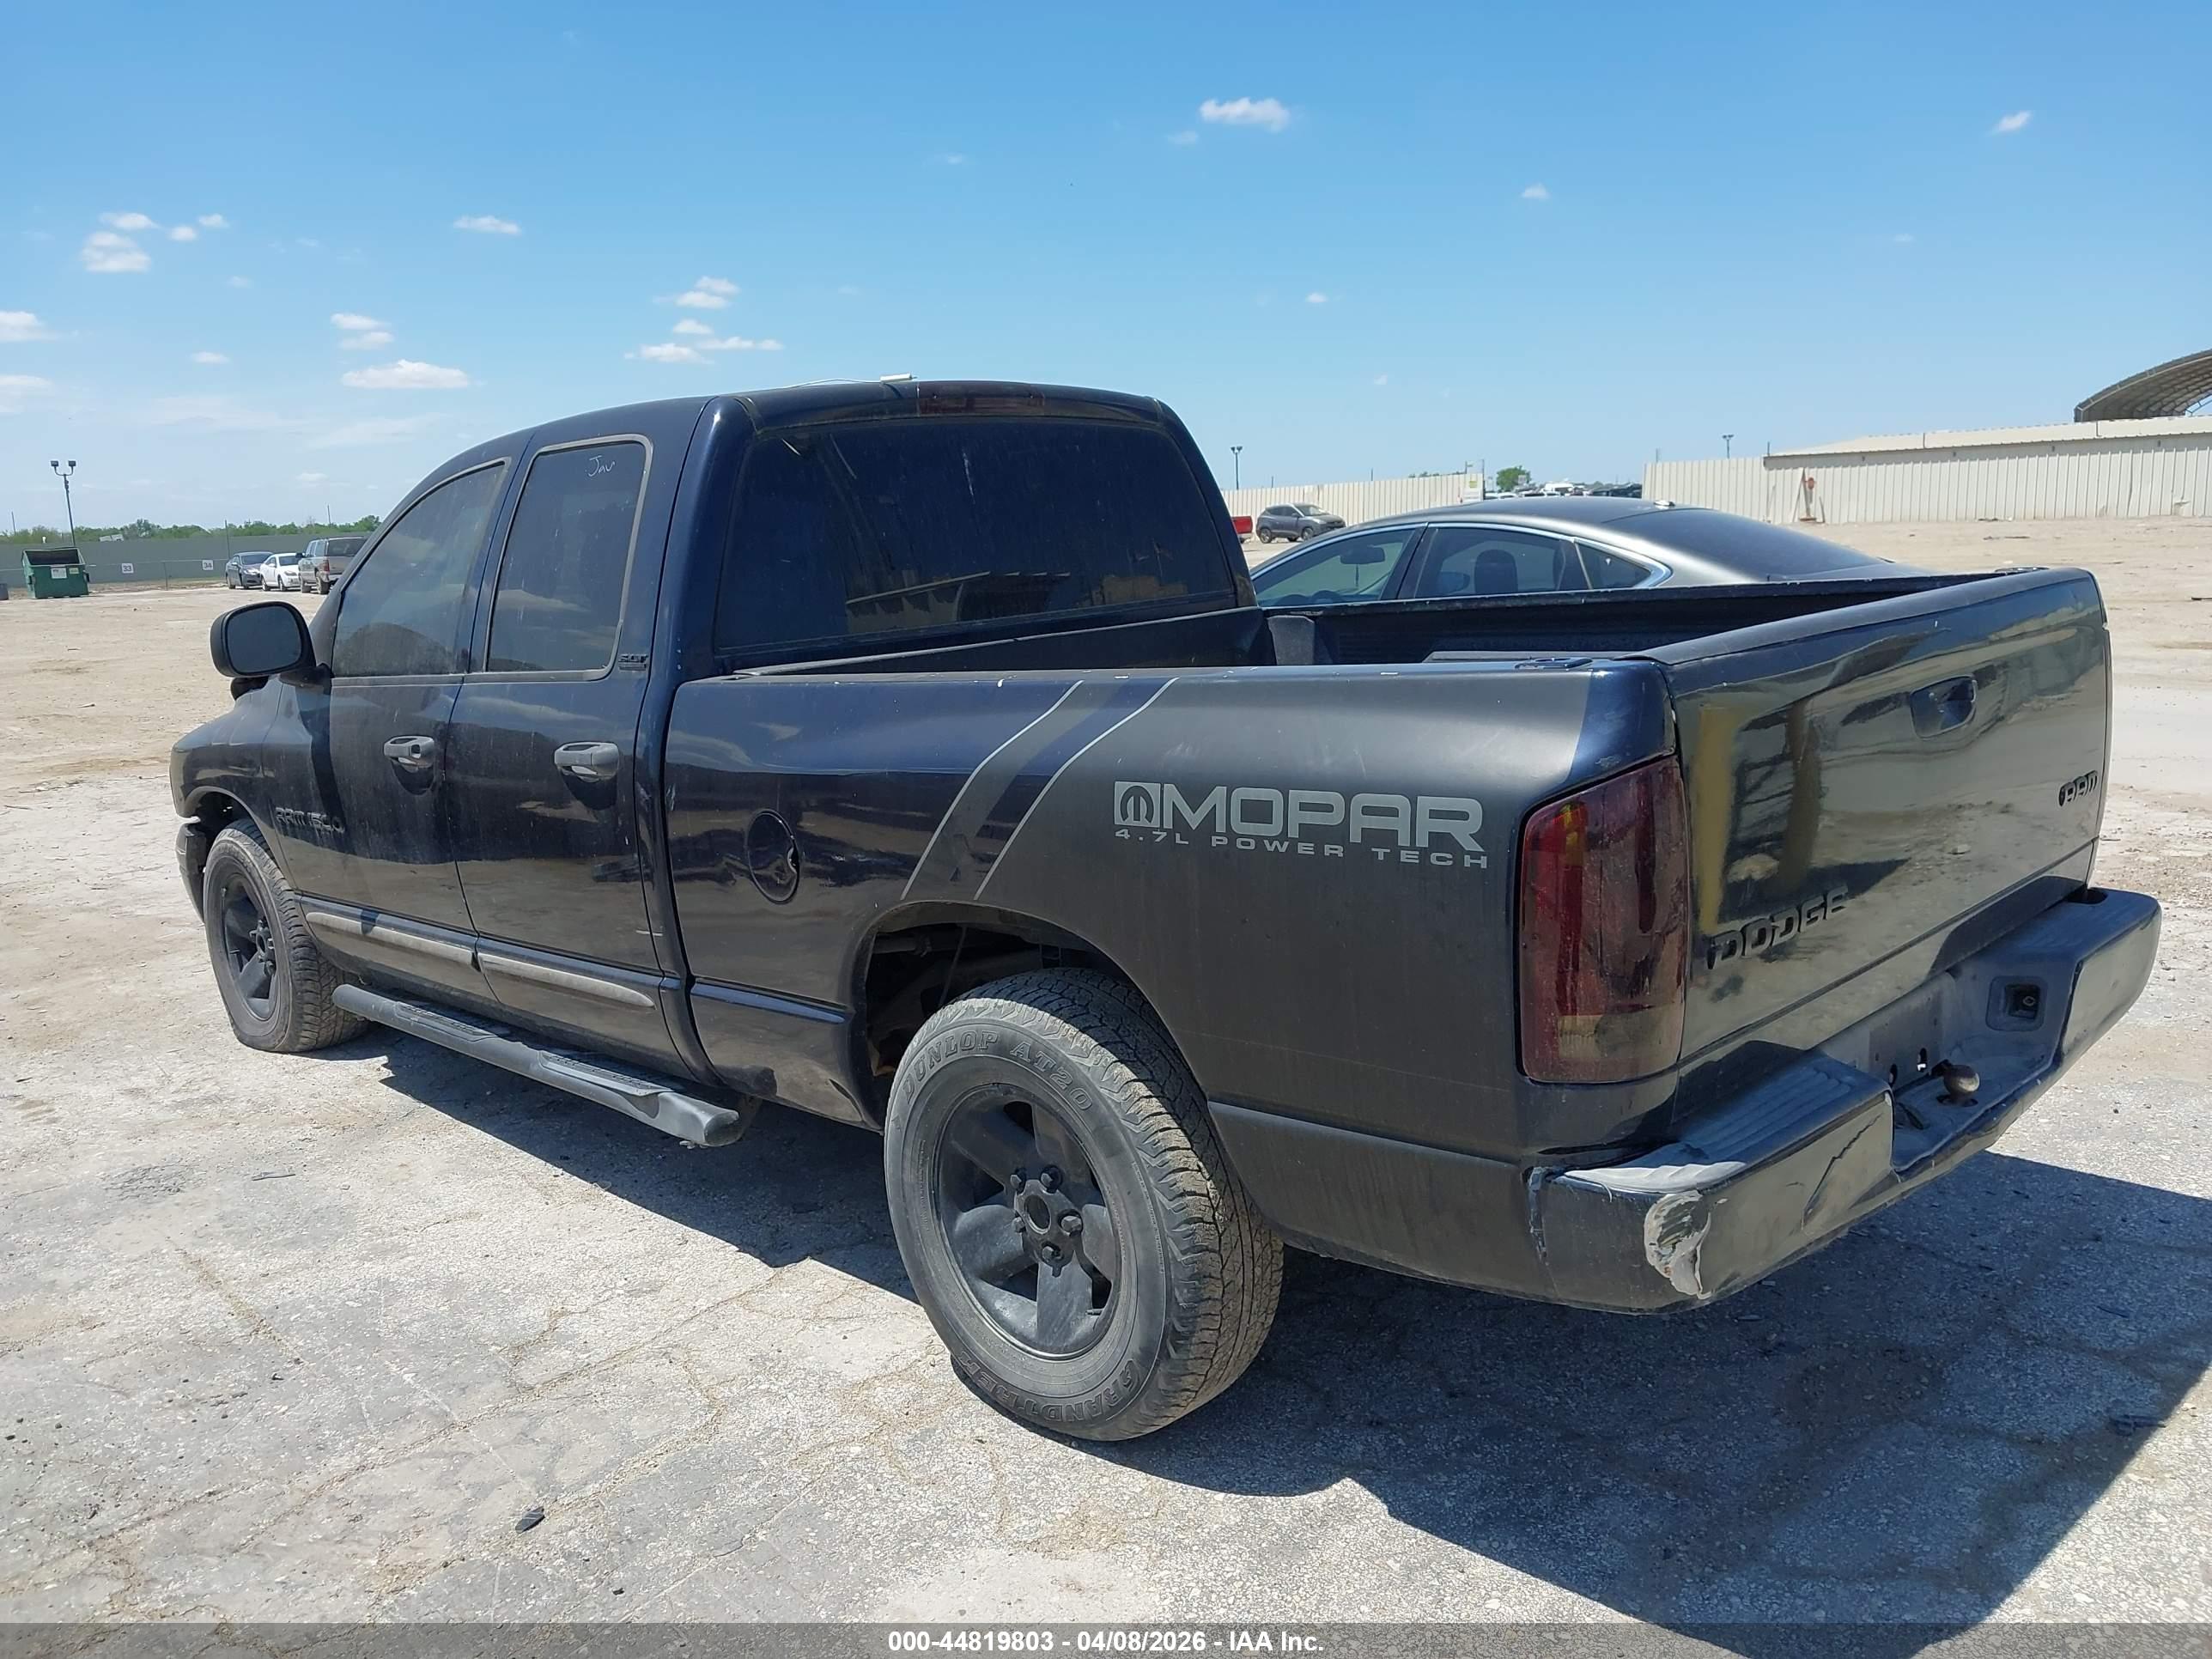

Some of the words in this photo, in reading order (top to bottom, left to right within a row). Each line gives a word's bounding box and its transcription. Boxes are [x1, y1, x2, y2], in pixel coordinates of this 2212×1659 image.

[1163, 783, 1486, 853] MOPAR
[2058, 770, 2098, 806] RAM
[1115, 828, 1189, 845] 4.7L
[1211, 835, 1344, 858] POWER
[1371, 847, 1488, 869] TECH
[1705, 885, 1849, 970] DODGE
[902, 1030, 1000, 1105] DUNLOP
[1010, 1040, 1093, 1111] AT20
[957, 1351, 1140, 1423] GRANDTREK
